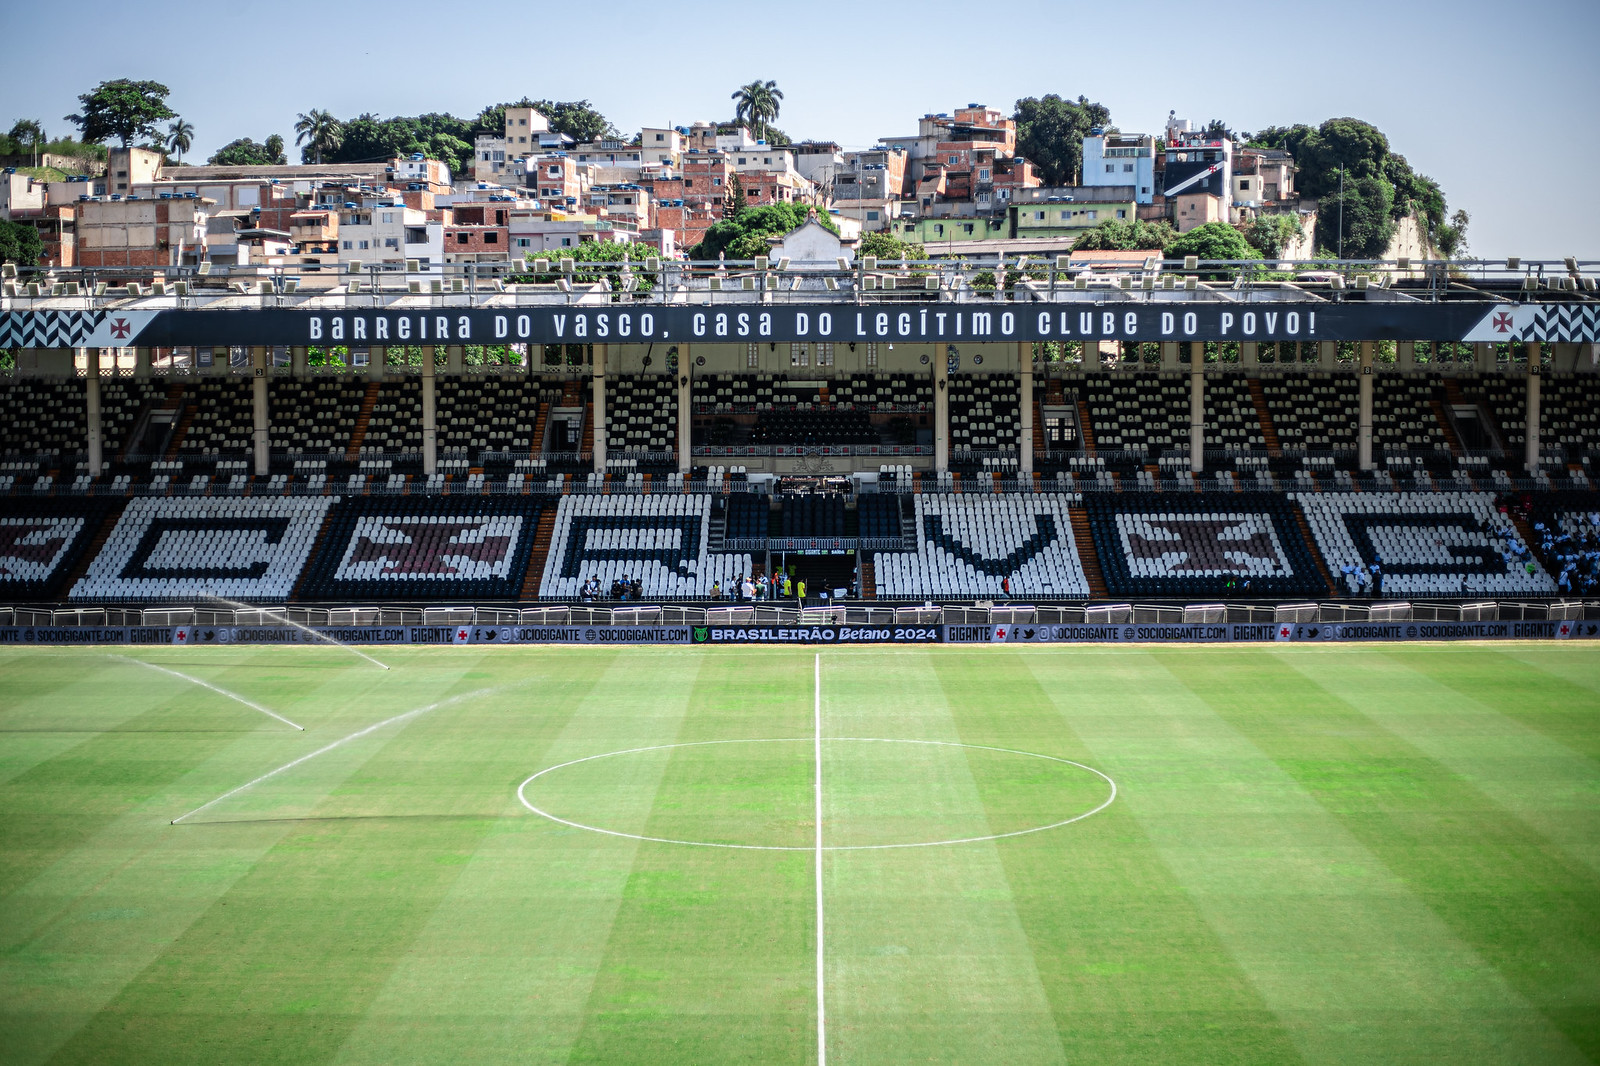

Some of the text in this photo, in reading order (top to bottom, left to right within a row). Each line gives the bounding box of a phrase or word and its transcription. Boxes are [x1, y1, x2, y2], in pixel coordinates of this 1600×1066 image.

[495, 315, 531, 338] DO
[796, 312, 832, 336] DO
[1161, 312, 1197, 335] DO
[1221, 311, 1315, 335] POVO!
[0, 630, 123, 642] NTE SOCIOGIGANTE.COM
[130, 629, 171, 643] GIGANTE
[315, 629, 404, 642] SOCIOGIGANTE.COM
[411, 628, 452, 643] GIGANTE
[513, 628, 580, 641] SOCIOGIGANTE
[599, 629, 688, 641] SOCIOGIGANTE.COM
[711, 627, 937, 640] BRASILEIRÃO Betano 2024
[949, 626, 991, 641] GIGANTE
[1051, 626, 1119, 640] SOCIOGIGANTE
[1137, 627, 1227, 640] SOCIOGIGANTE.COM
[1233, 625, 1275, 640] GIGANTE
[1335, 625, 1402, 639] SOCIOGIGANTE
[1419, 625, 1508, 638] SOCIOGIGANTE.COM
[1514, 623, 1555, 638] GIGANTE
